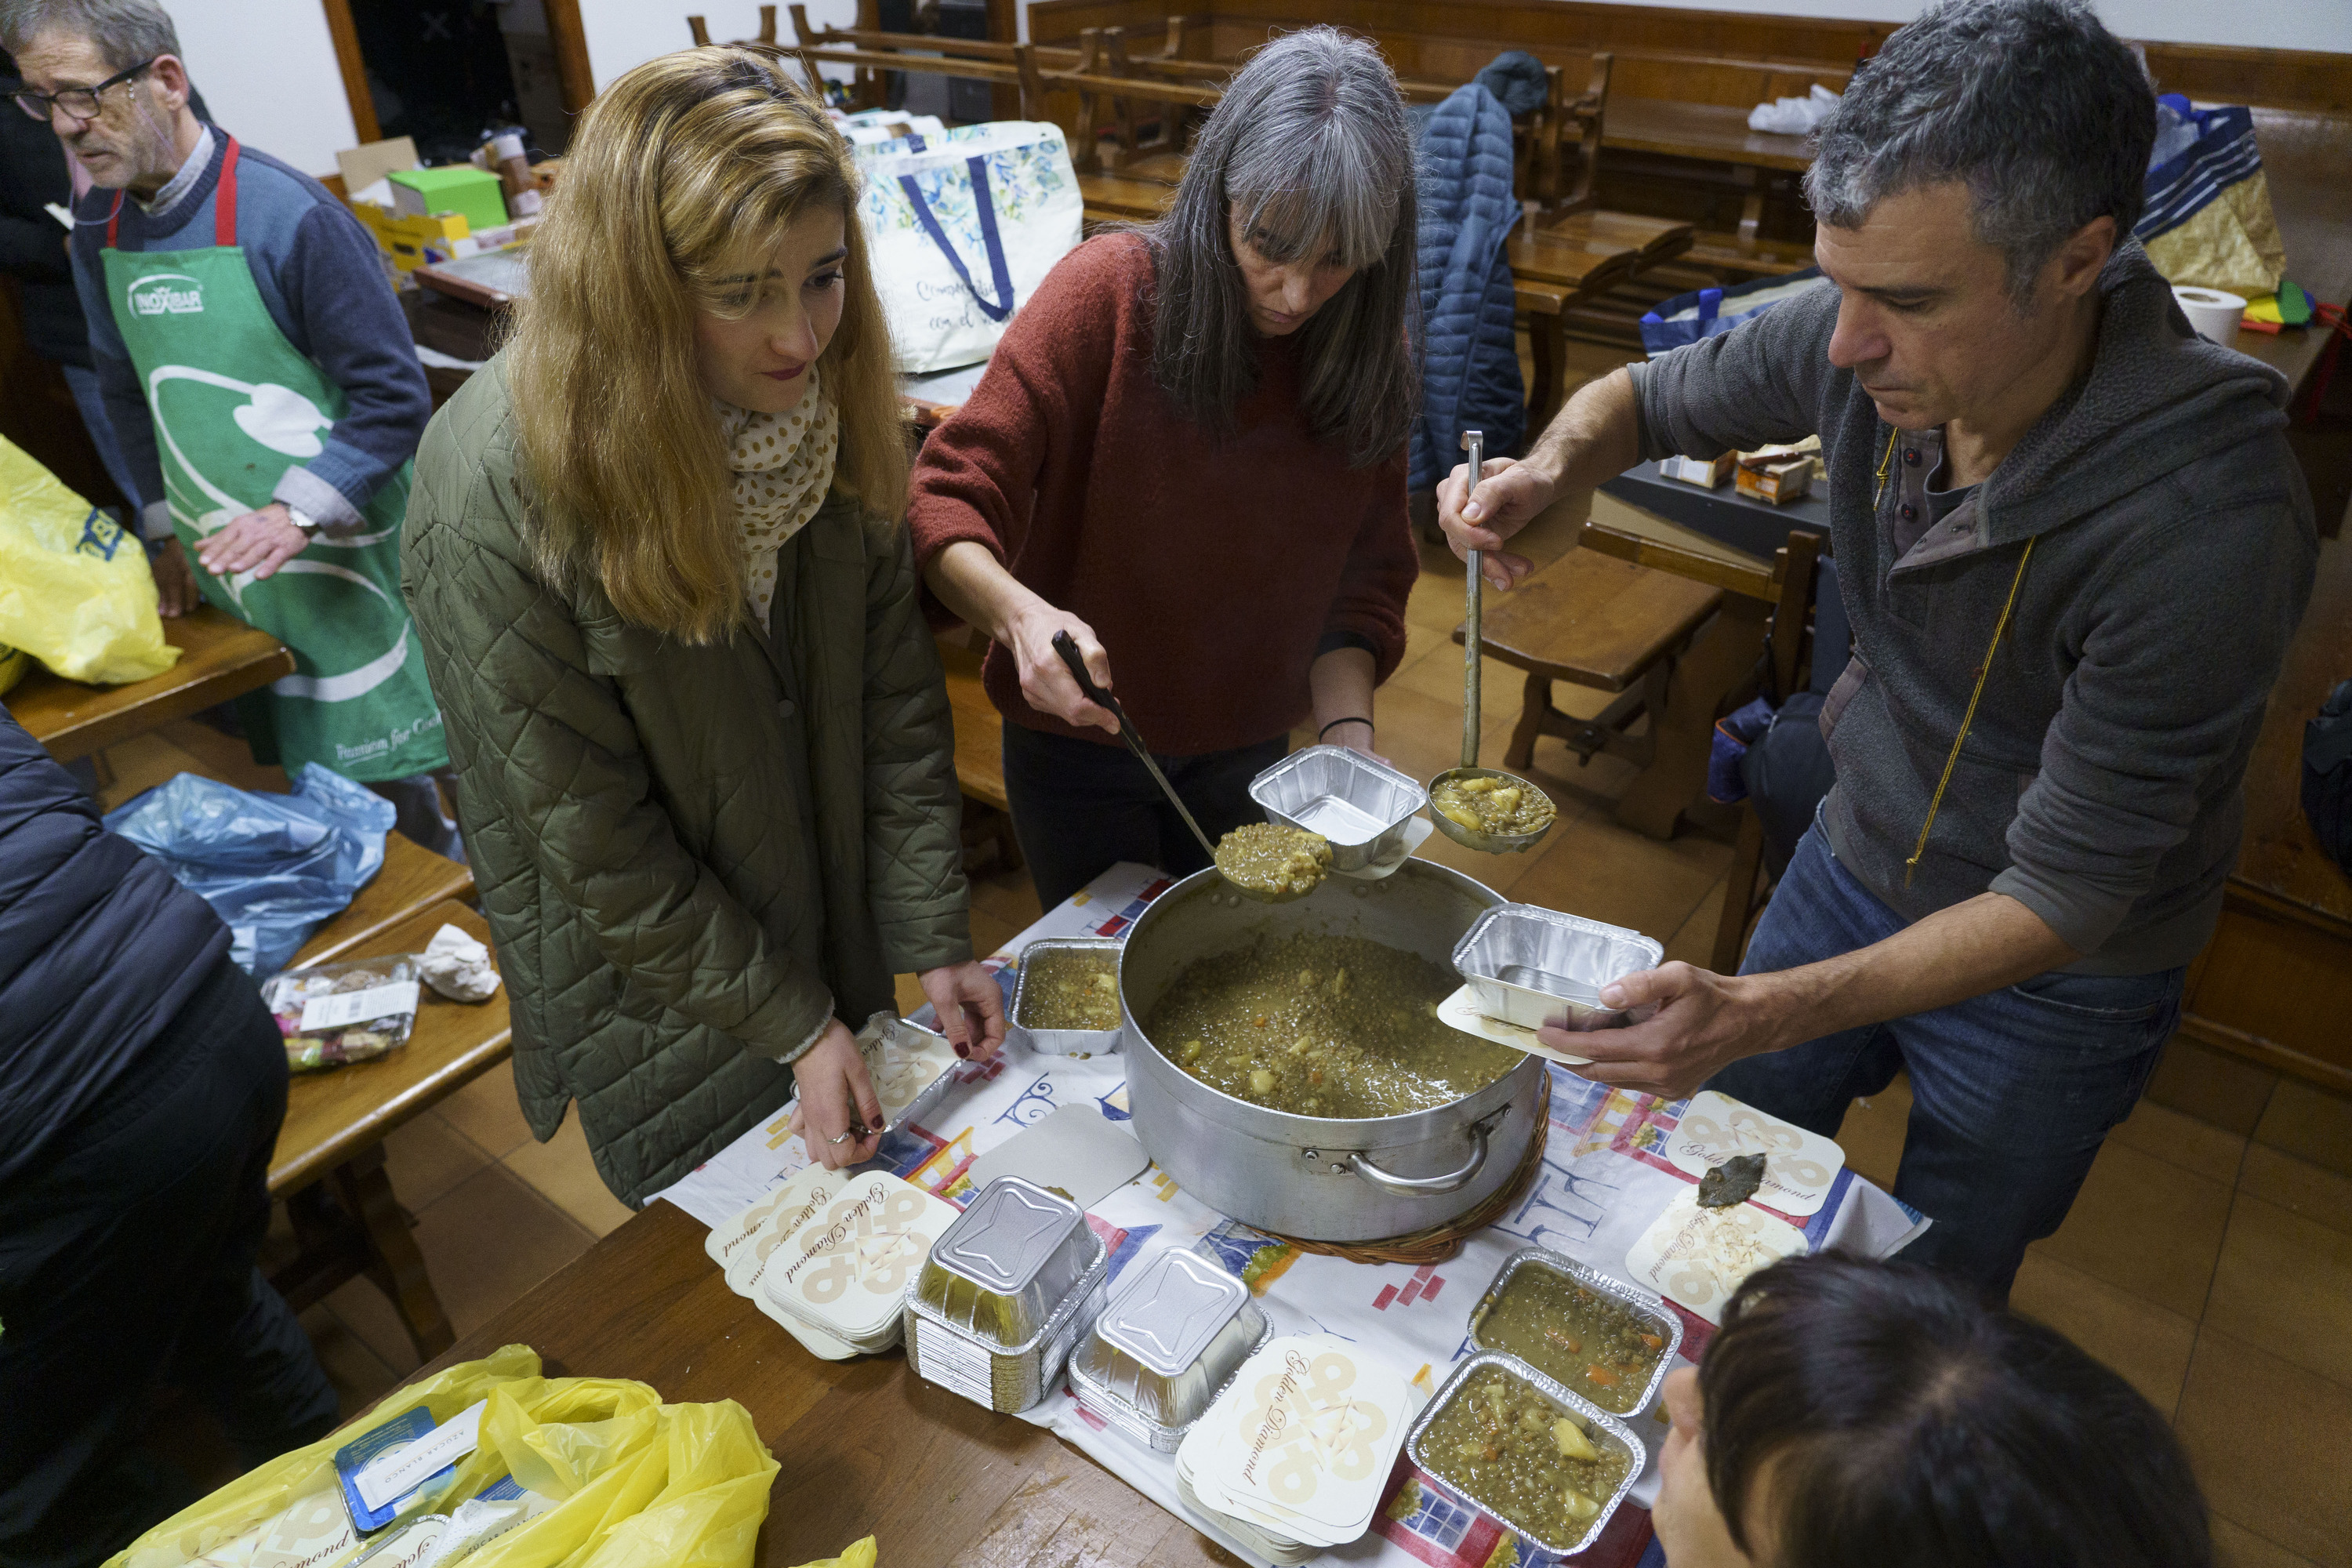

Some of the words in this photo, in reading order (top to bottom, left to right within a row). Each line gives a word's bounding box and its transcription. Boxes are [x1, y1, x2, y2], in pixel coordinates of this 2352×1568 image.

[1679, 1141, 1725, 1166] Golde
[793, 1186, 833, 1229] Golden
[844, 1181, 891, 1223] Golden
[784, 1222, 847, 1283] Diamond
[1648, 1230, 1695, 1283] Diamond
[1274, 1349, 1311, 1403] Golden
[1242, 1404, 1287, 1486] Diamond
[384, 1457, 423, 1483] BLANCO
